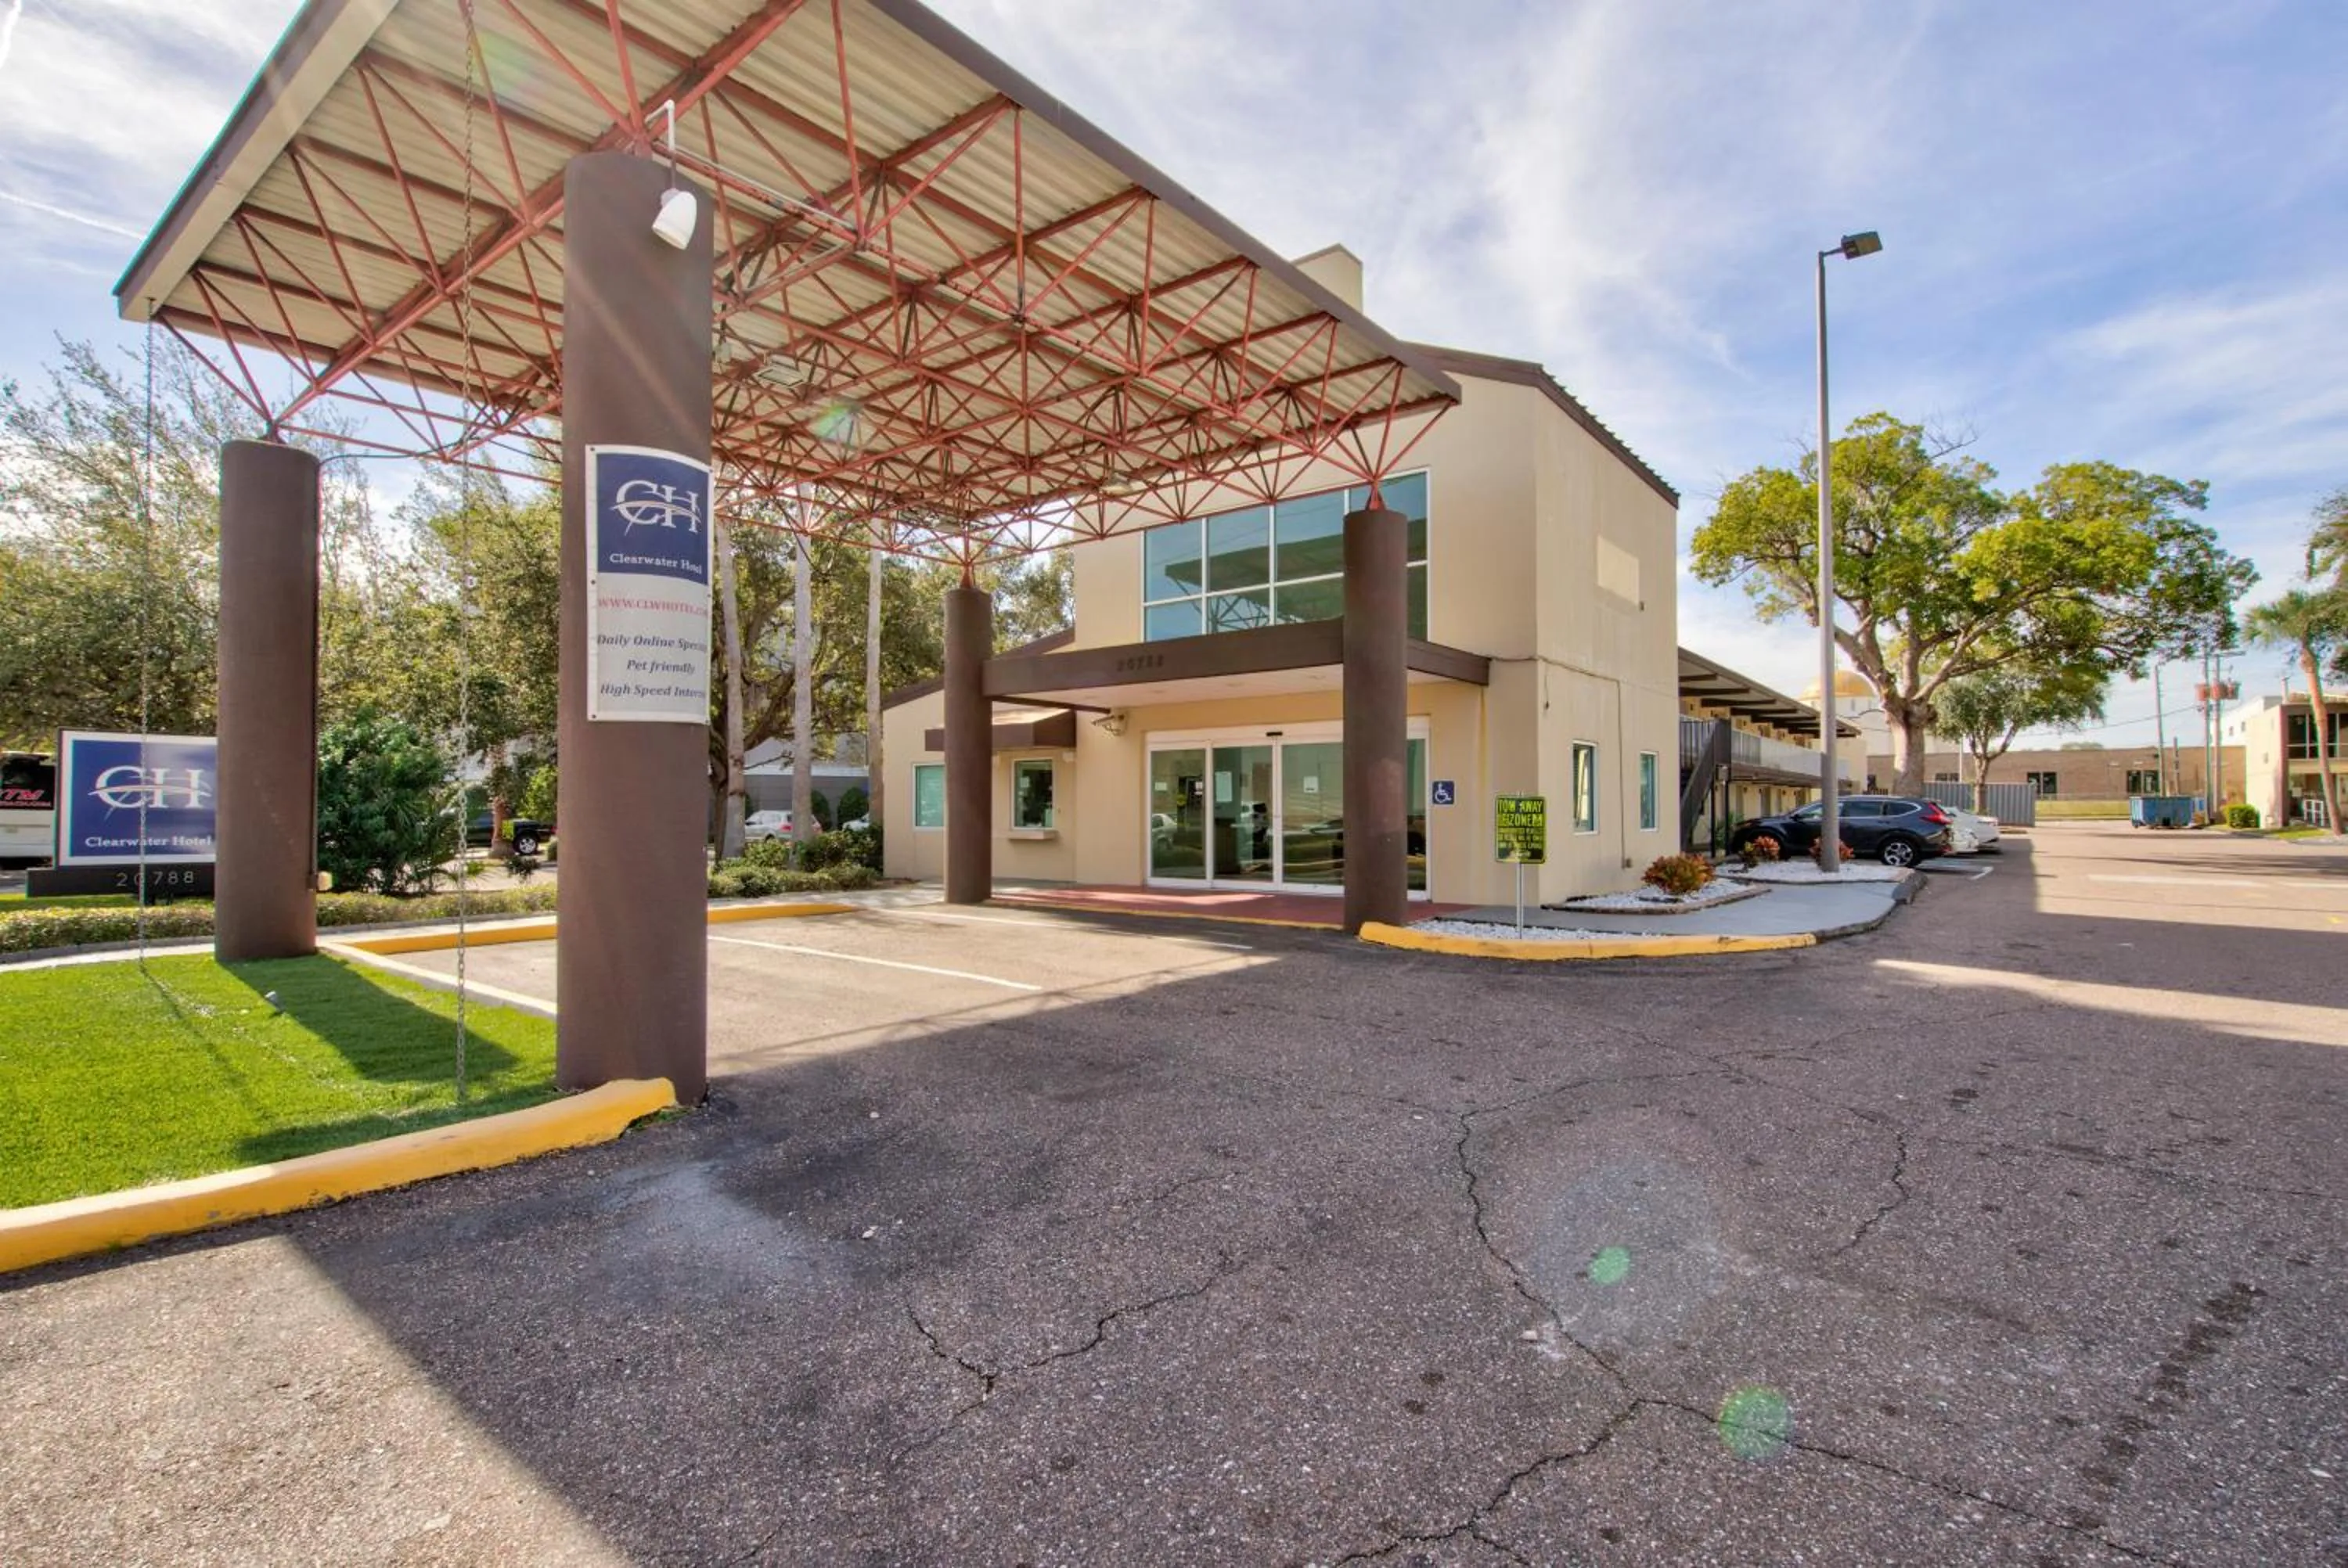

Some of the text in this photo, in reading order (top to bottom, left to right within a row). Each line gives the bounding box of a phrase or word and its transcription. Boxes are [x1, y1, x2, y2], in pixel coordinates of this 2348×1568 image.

[610, 553, 678, 567] Clearwater
[597, 635, 631, 647] Daily
[633, 635, 675, 648] Online
[627, 660, 695, 674] Pet friendly
[600, 683, 631, 697] High
[634, 685, 672, 698] Speed
[85, 835, 211, 847] Clearwater Hotel
[117, 871, 195, 886] 20788
